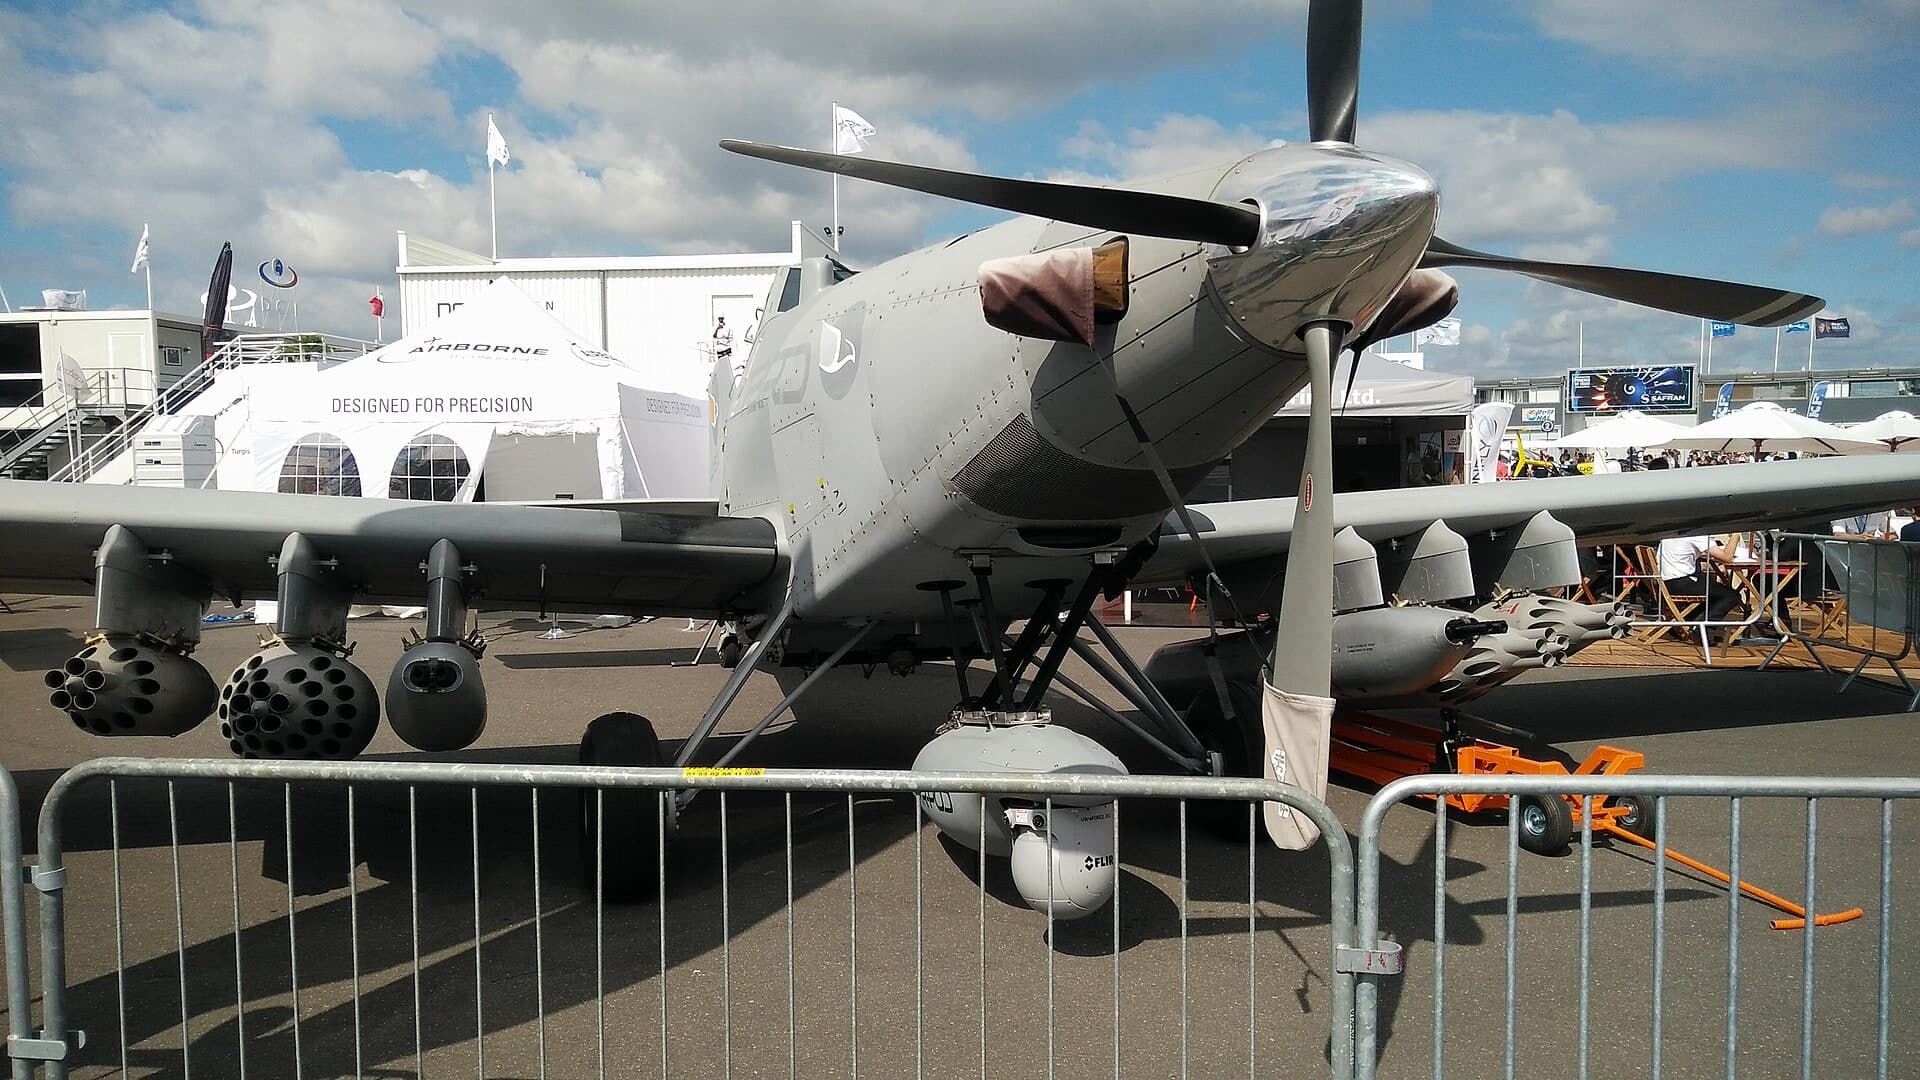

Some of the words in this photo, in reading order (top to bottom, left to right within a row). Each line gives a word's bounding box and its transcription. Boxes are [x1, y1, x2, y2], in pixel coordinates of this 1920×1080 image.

[407, 342, 550, 357] AIRBORNE
[332, 397, 410, 414] DESIGNED
[415, 397, 444, 414] FOR
[449, 396, 533, 413] PRECISION
[1650, 394, 1686, 402] SAFRAN
[1094, 854, 1114, 868] FLIR
